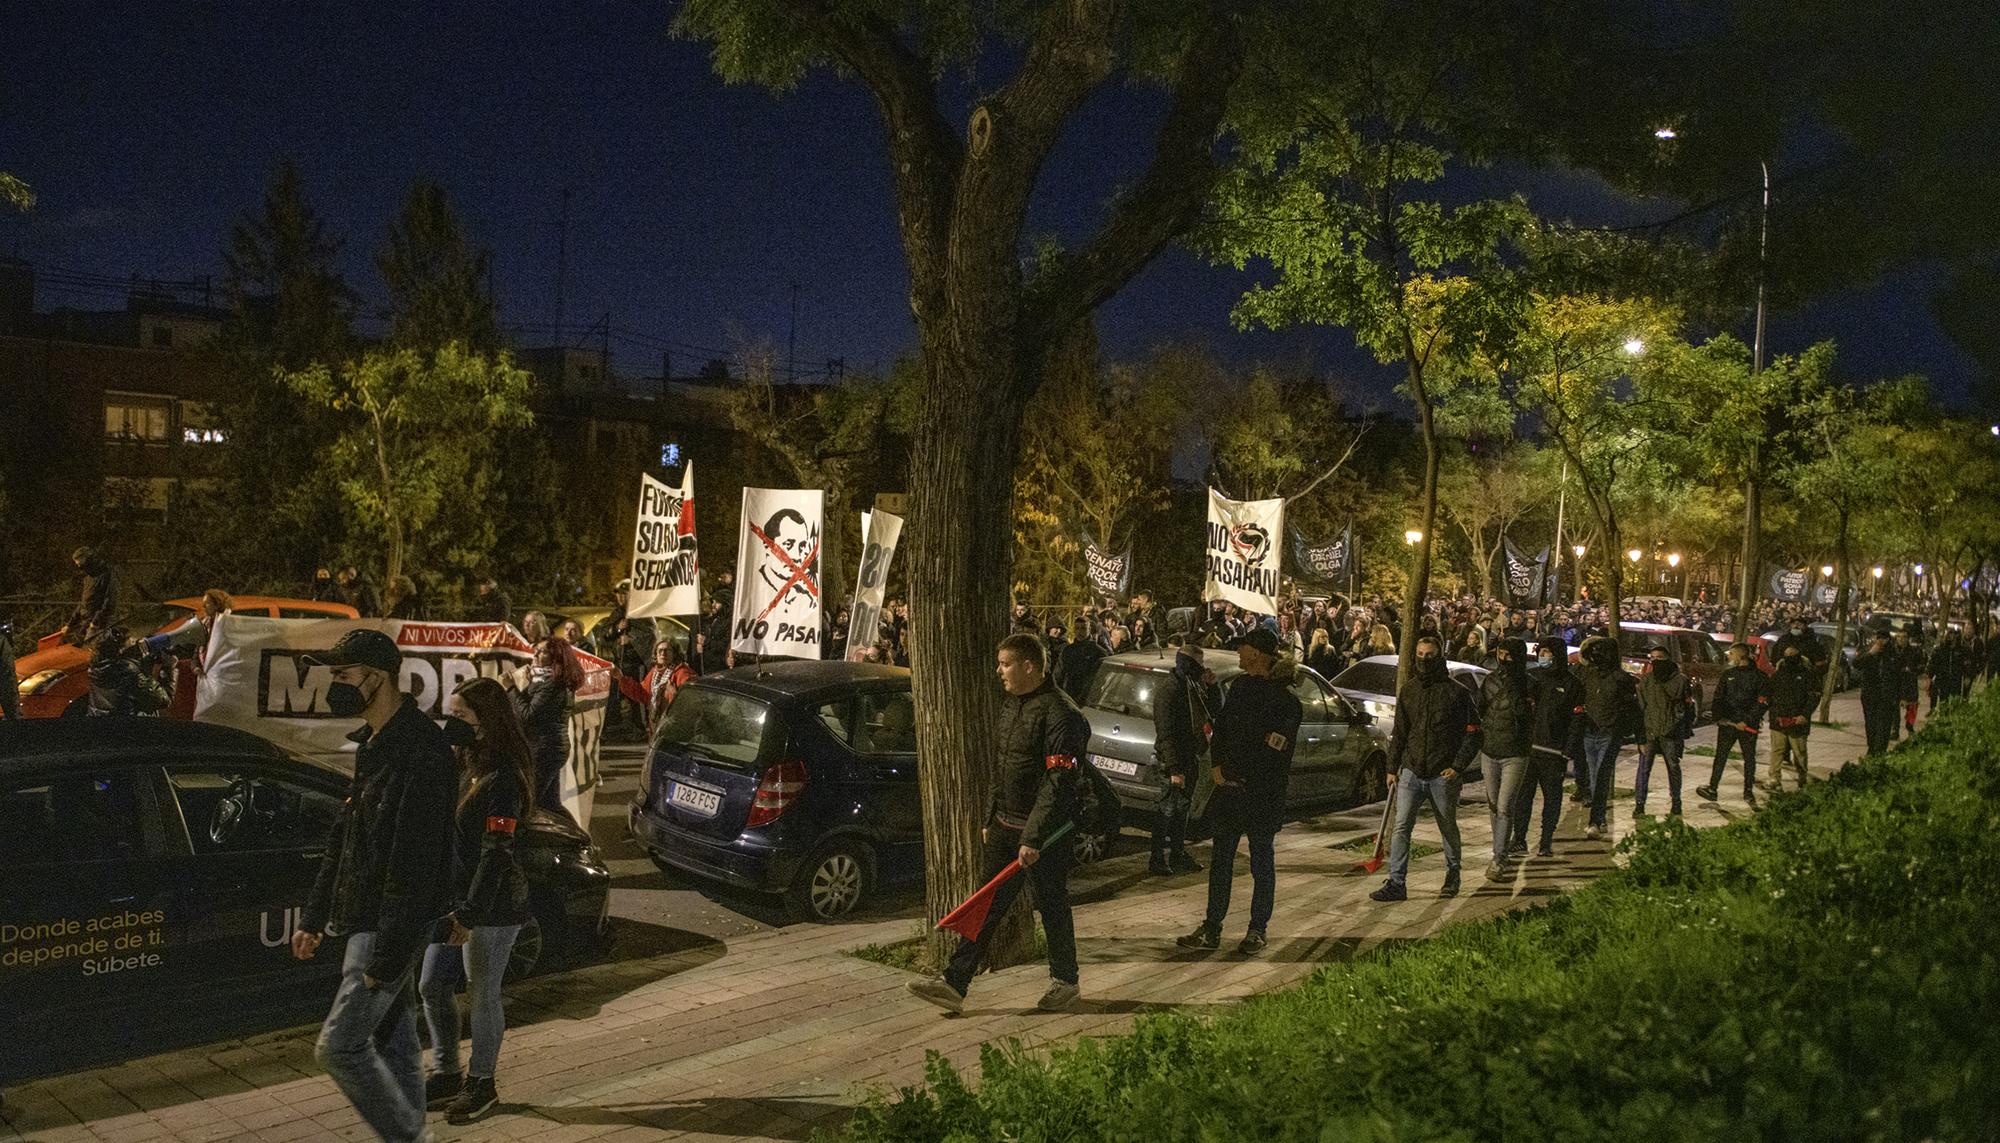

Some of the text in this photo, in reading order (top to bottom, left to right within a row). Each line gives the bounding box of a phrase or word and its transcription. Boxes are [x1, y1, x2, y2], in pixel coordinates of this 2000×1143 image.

[1207, 522, 1229, 553] NO
[1315, 560, 1341, 571] OLGA
[405, 629, 418, 641] NI
[423, 629, 466, 643] VIVOS
[733, 618, 769, 640] NO
[676, 786, 716, 810] 1282 FCS
[1, 910, 165, 943] Donde acabes
[2, 928, 165, 966] depende de ti.
[82, 952, 164, 976] Súbete.
